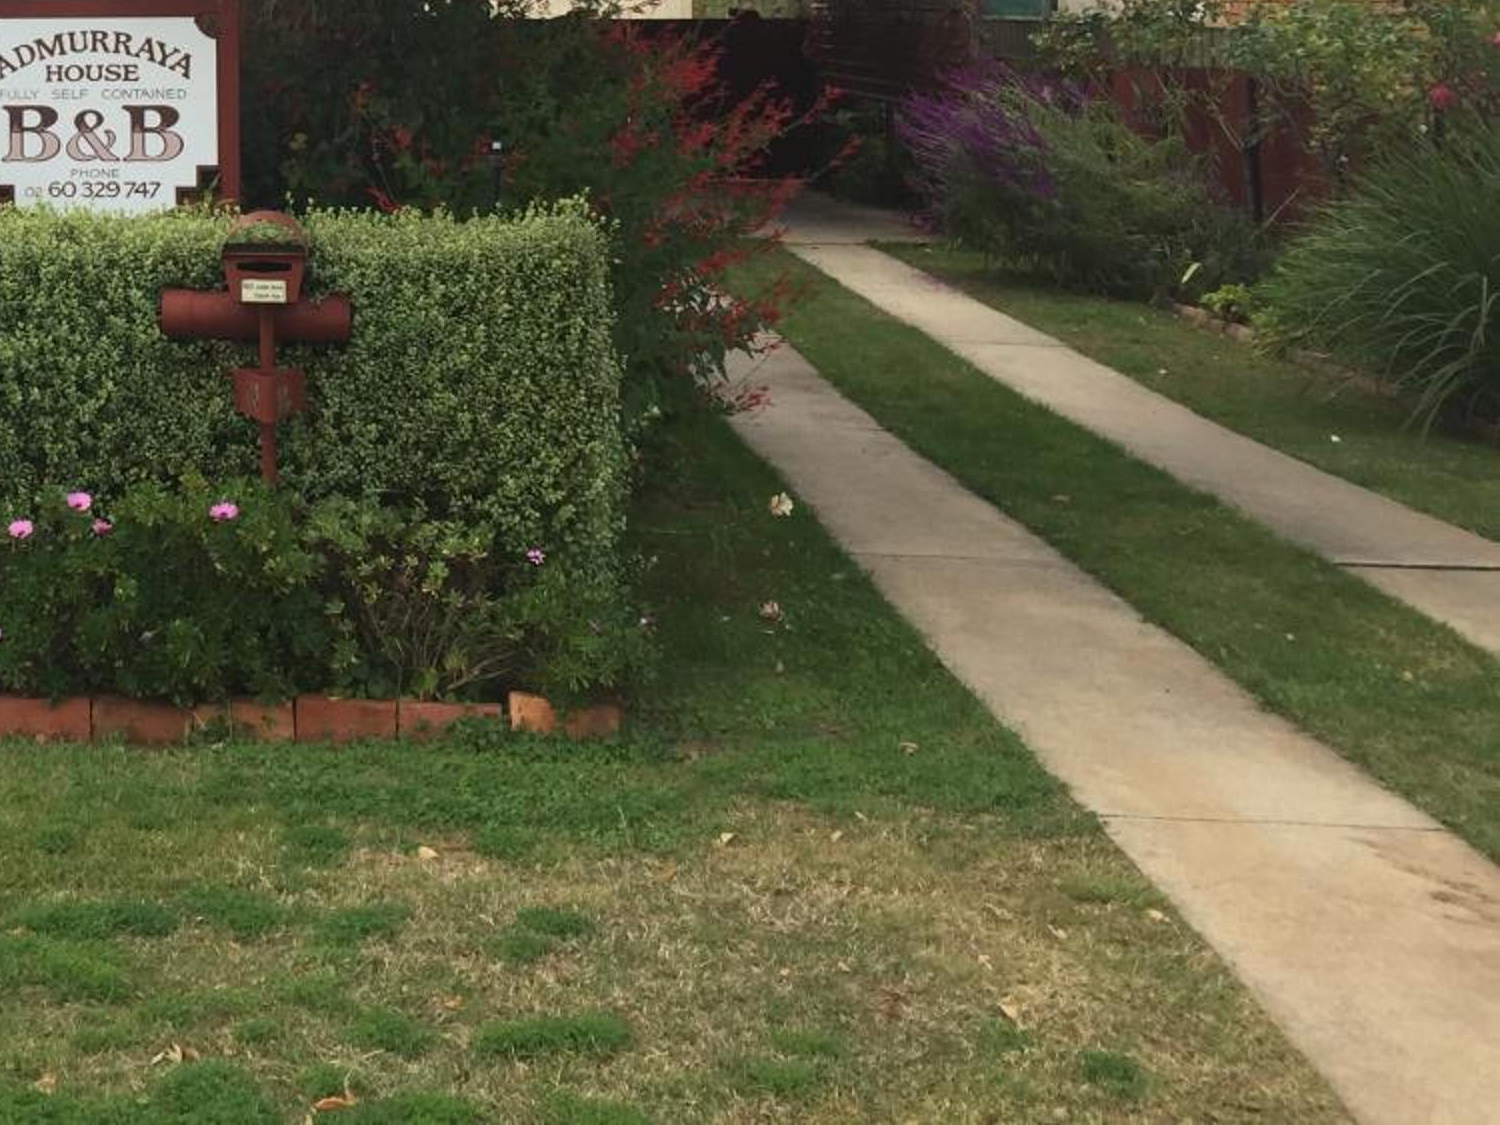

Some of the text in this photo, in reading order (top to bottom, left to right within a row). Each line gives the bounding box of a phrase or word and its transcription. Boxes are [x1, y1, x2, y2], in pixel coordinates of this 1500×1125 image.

[45, 65, 140, 82] HOUSE
[0, 88, 187, 100] FULLY SELF CONTAINED
[2, 104, 184, 162] B&B
[71, 168, 120, 178] PHONE
[48, 182, 77, 198] 60
[80, 182, 121, 198] 329
[124, 181, 161, 198] 747
